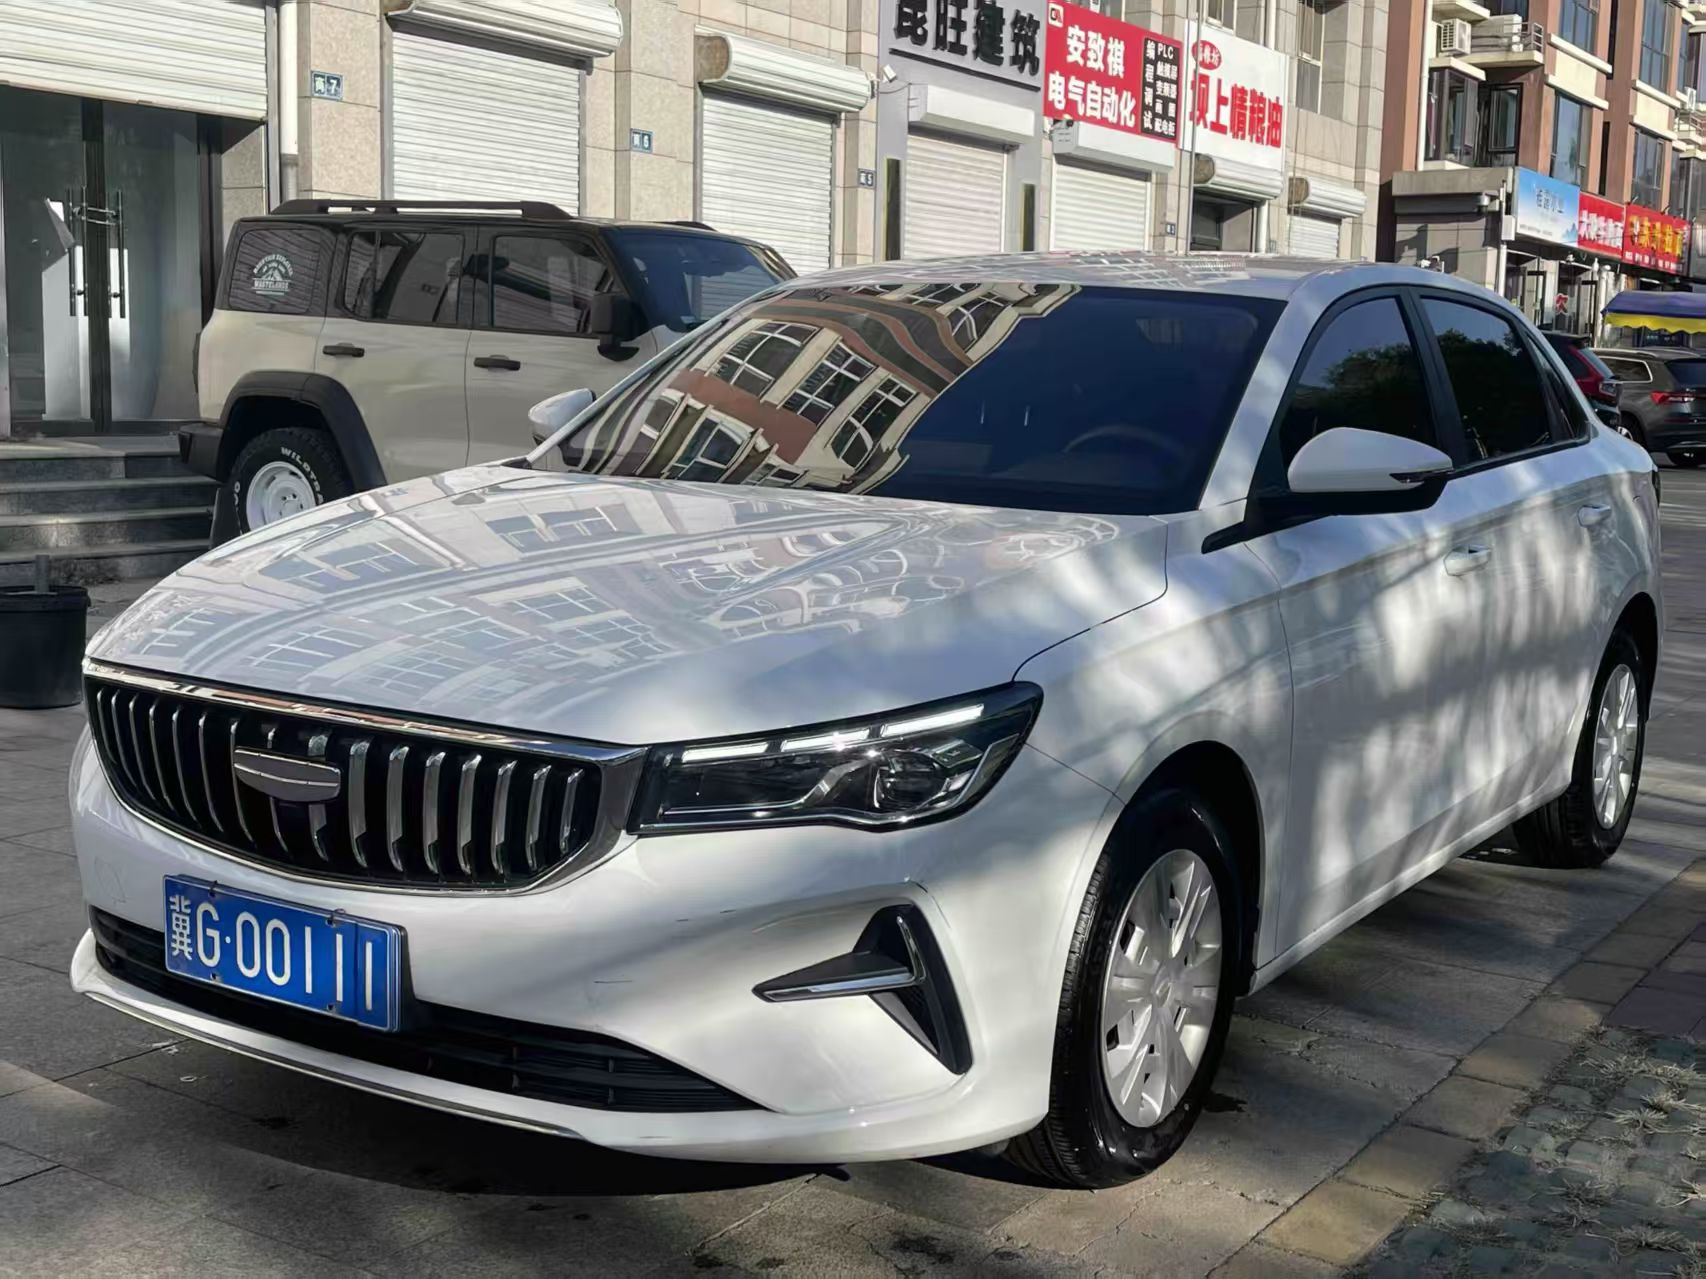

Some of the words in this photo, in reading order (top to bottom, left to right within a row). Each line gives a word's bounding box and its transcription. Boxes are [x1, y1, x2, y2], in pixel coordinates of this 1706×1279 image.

[1157, 42, 1174, 60] PLC
[1048, 70, 1136, 128] 电气自动化
